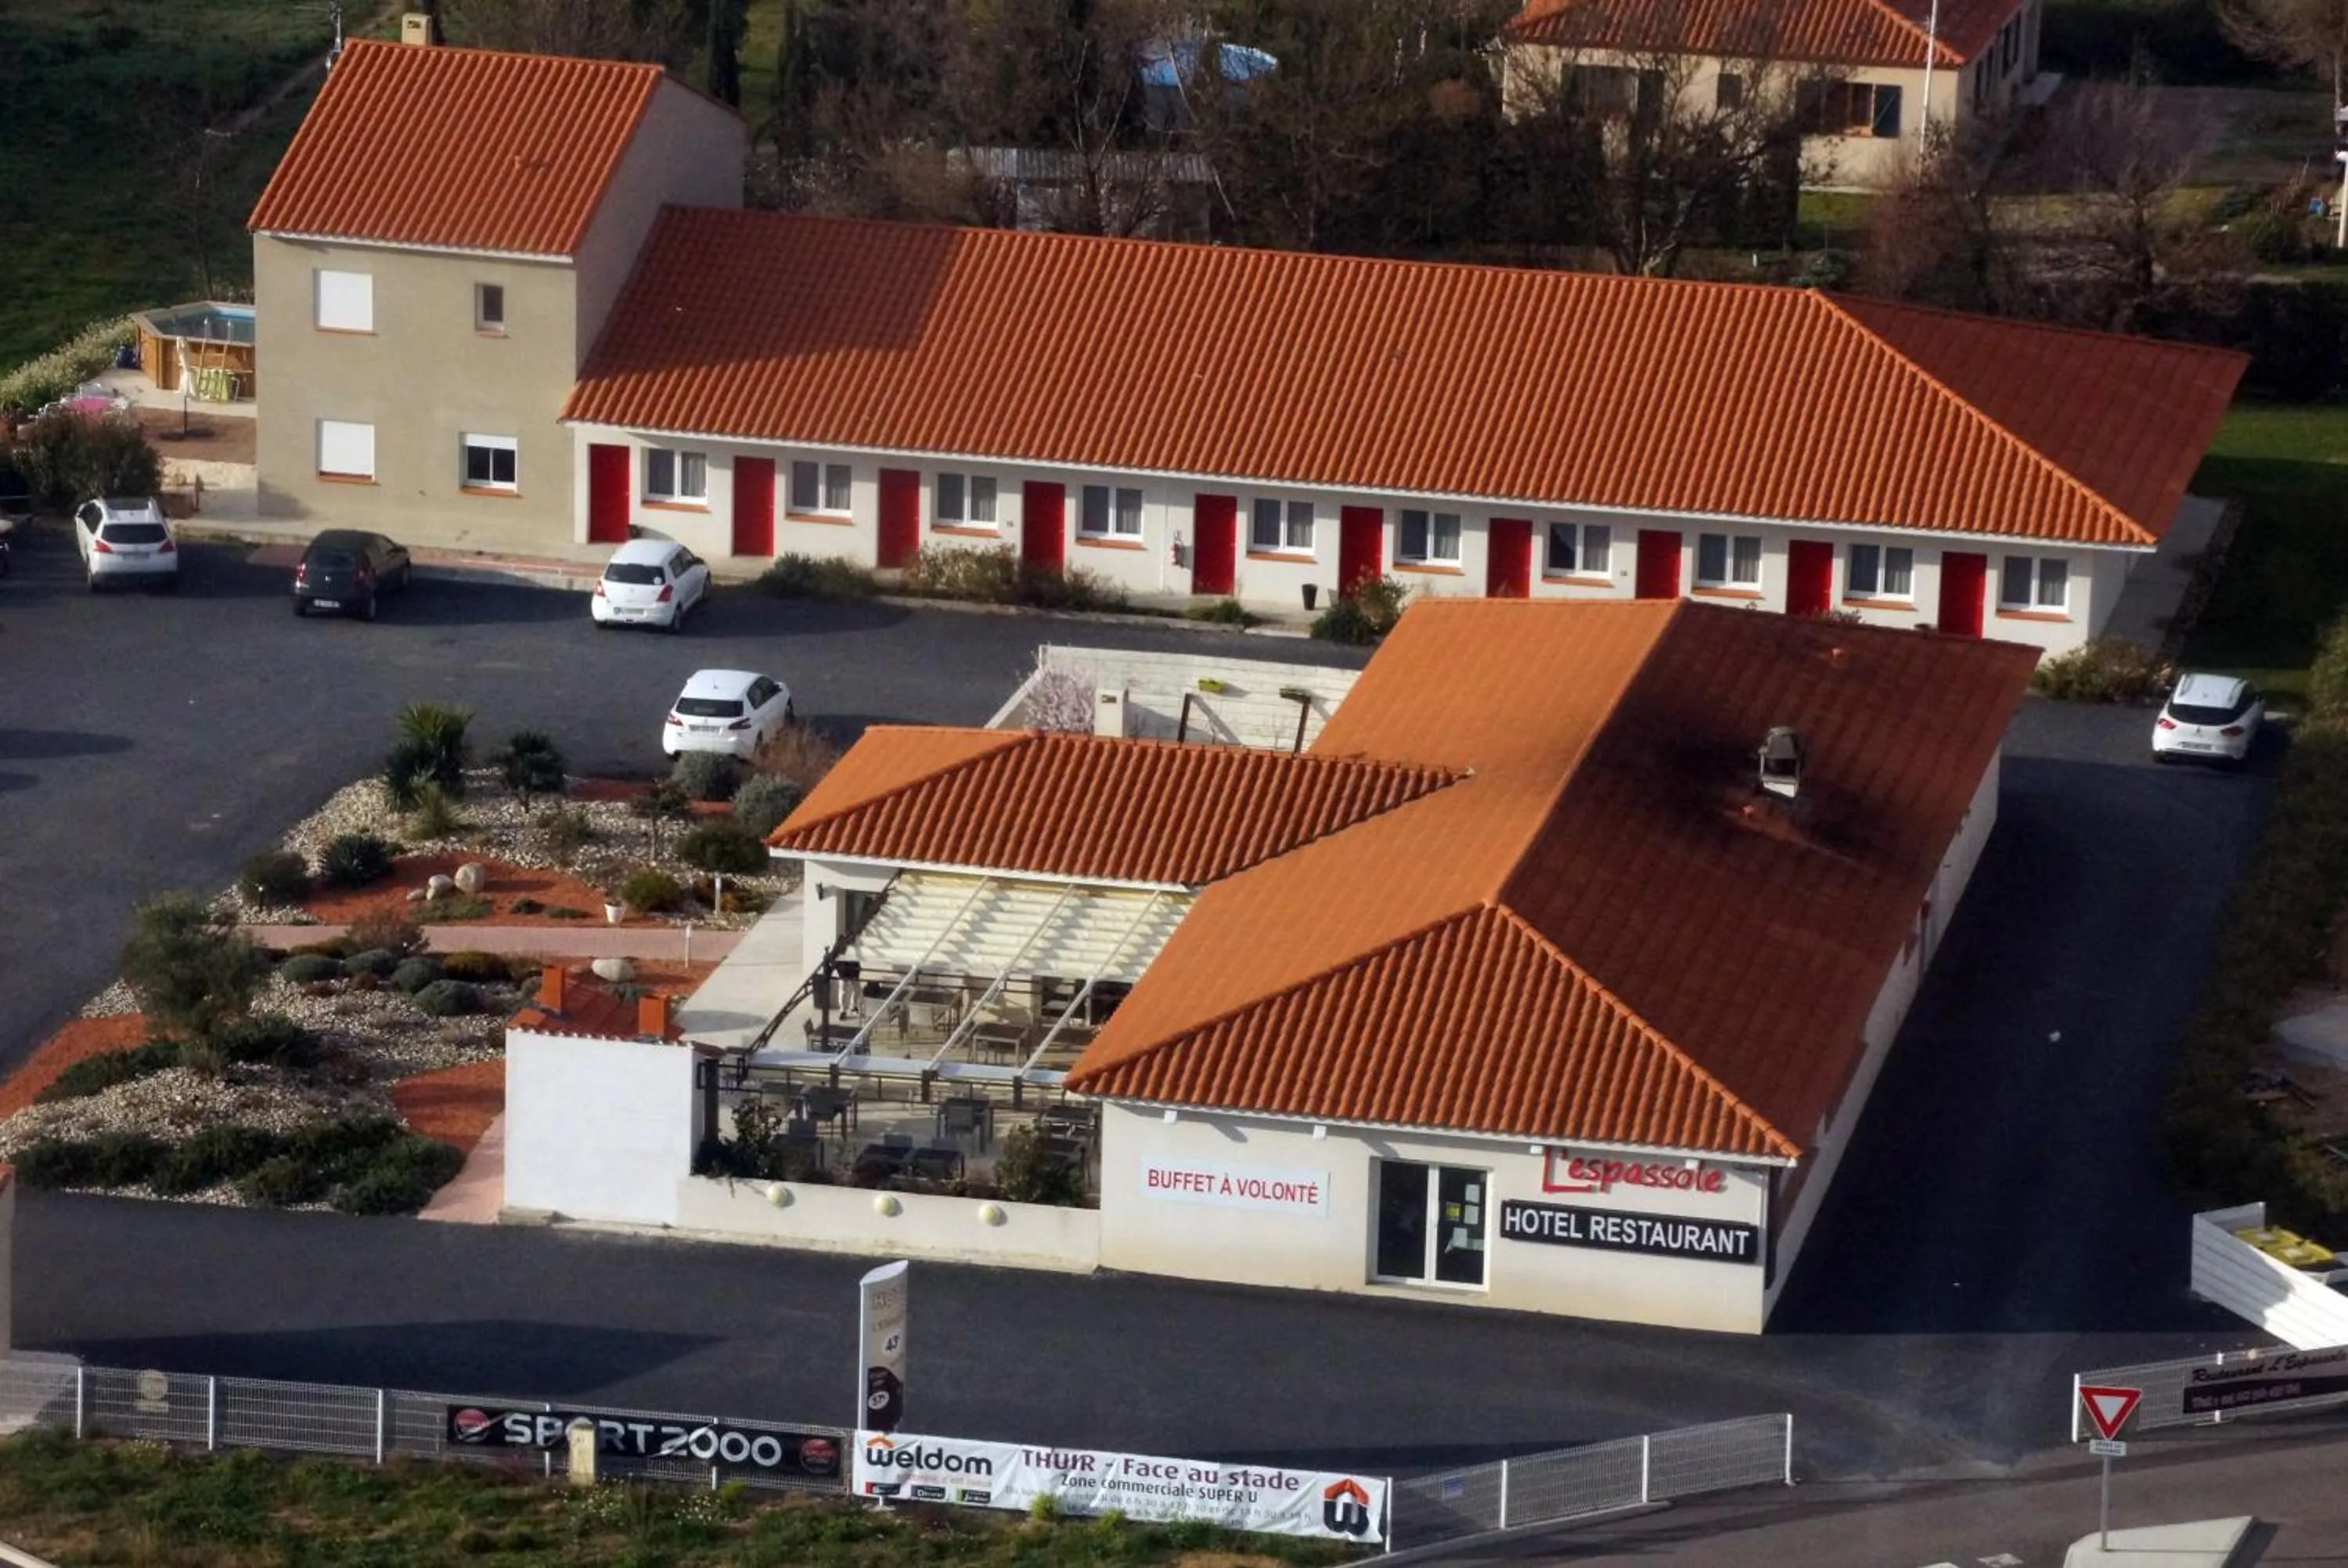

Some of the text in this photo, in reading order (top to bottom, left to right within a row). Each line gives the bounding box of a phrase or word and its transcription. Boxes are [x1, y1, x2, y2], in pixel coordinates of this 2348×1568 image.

[1148, 1168, 1318, 1203] BUFFET À VOLONTÉ
[1543, 1146, 1724, 1194] L'espassole
[1504, 1207, 1750, 1255] HOTEL RESTAURANT
[866, 1445, 992, 1476] weldom
[1022, 1449, 1095, 1472] THUIR
[1123, 1458, 1179, 1478] Face
[1187, 1466, 1219, 1485] au
[1229, 1471, 1299, 1491] stade
[1061, 1473, 1258, 1503] Zone commerciale SUPER U
